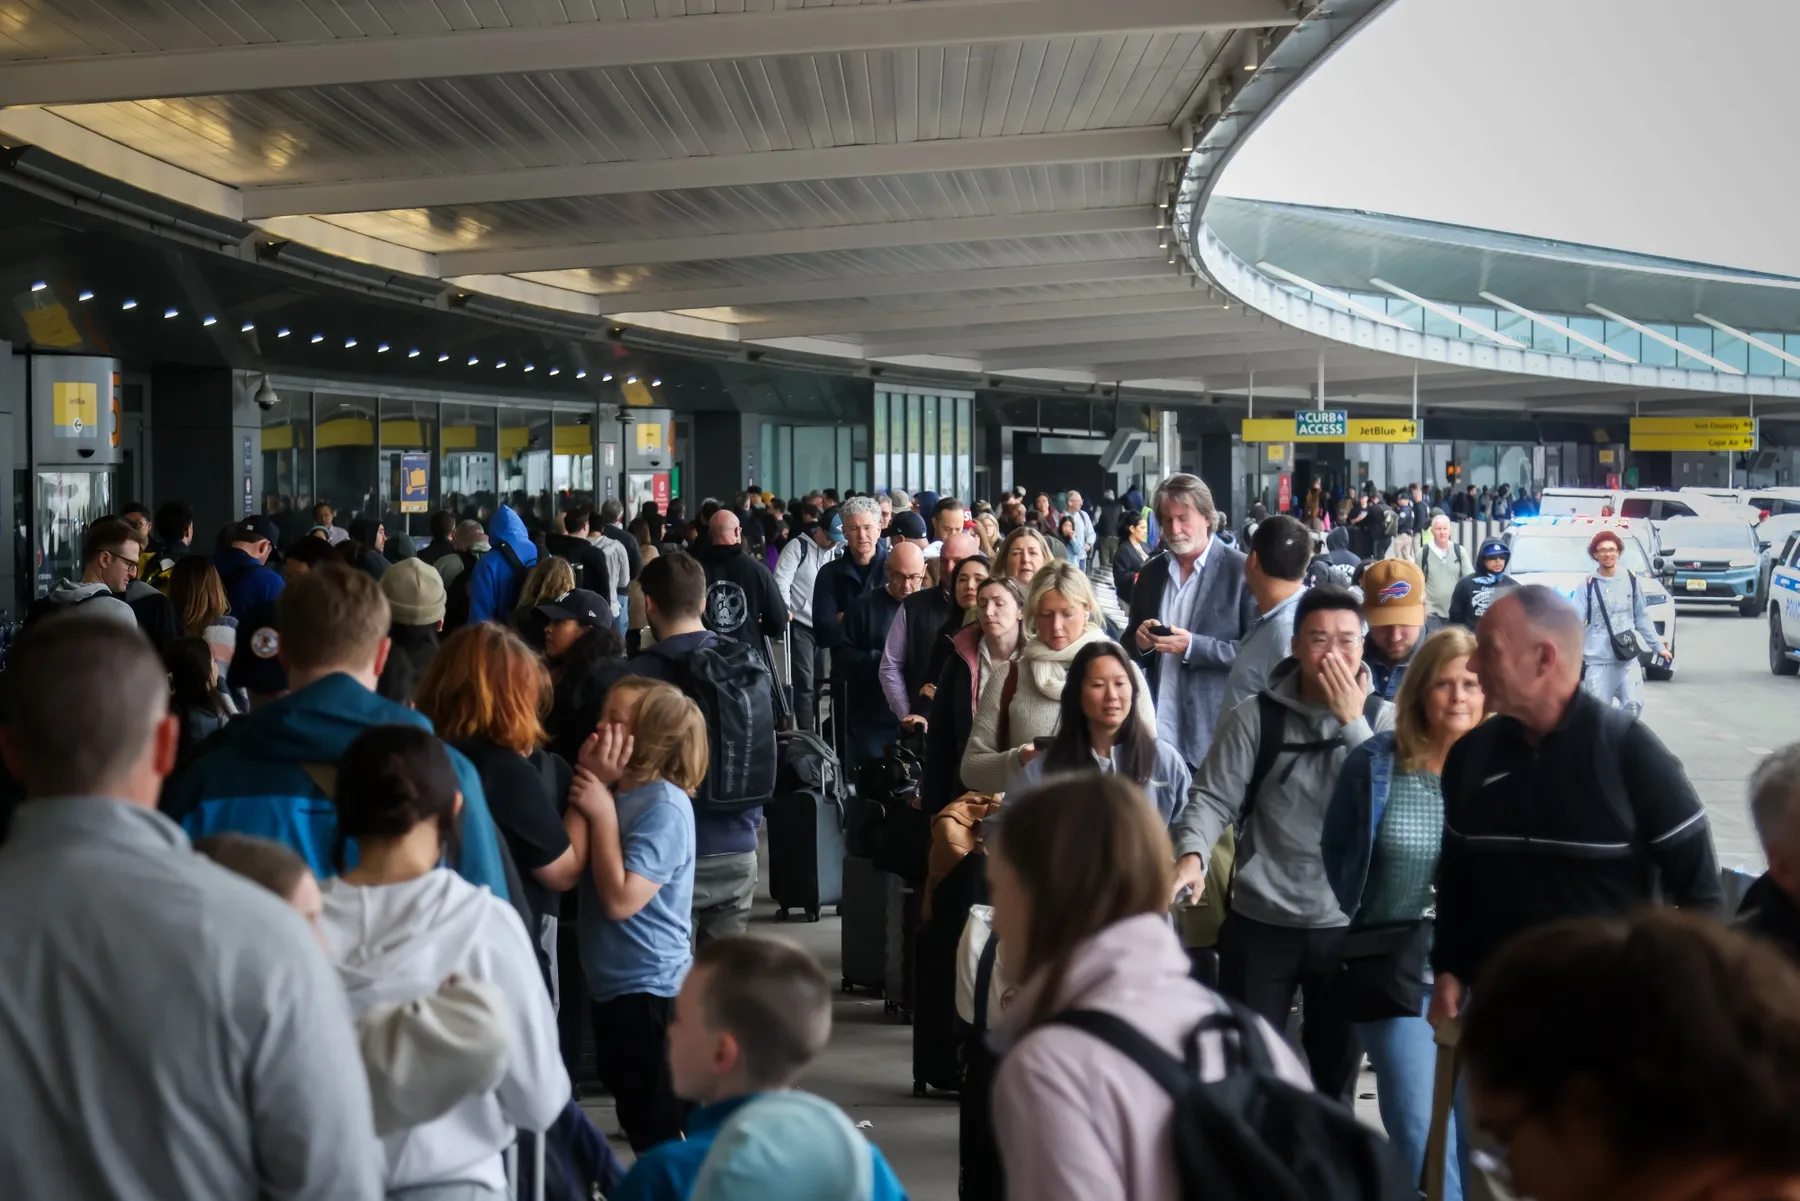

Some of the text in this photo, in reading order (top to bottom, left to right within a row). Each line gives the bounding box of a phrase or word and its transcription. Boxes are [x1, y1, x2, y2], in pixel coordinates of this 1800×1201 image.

[1305, 412, 1336, 423] CURB
[1299, 423, 1342, 435] ACCESS
[1360, 426, 1396, 436] JetBlue
